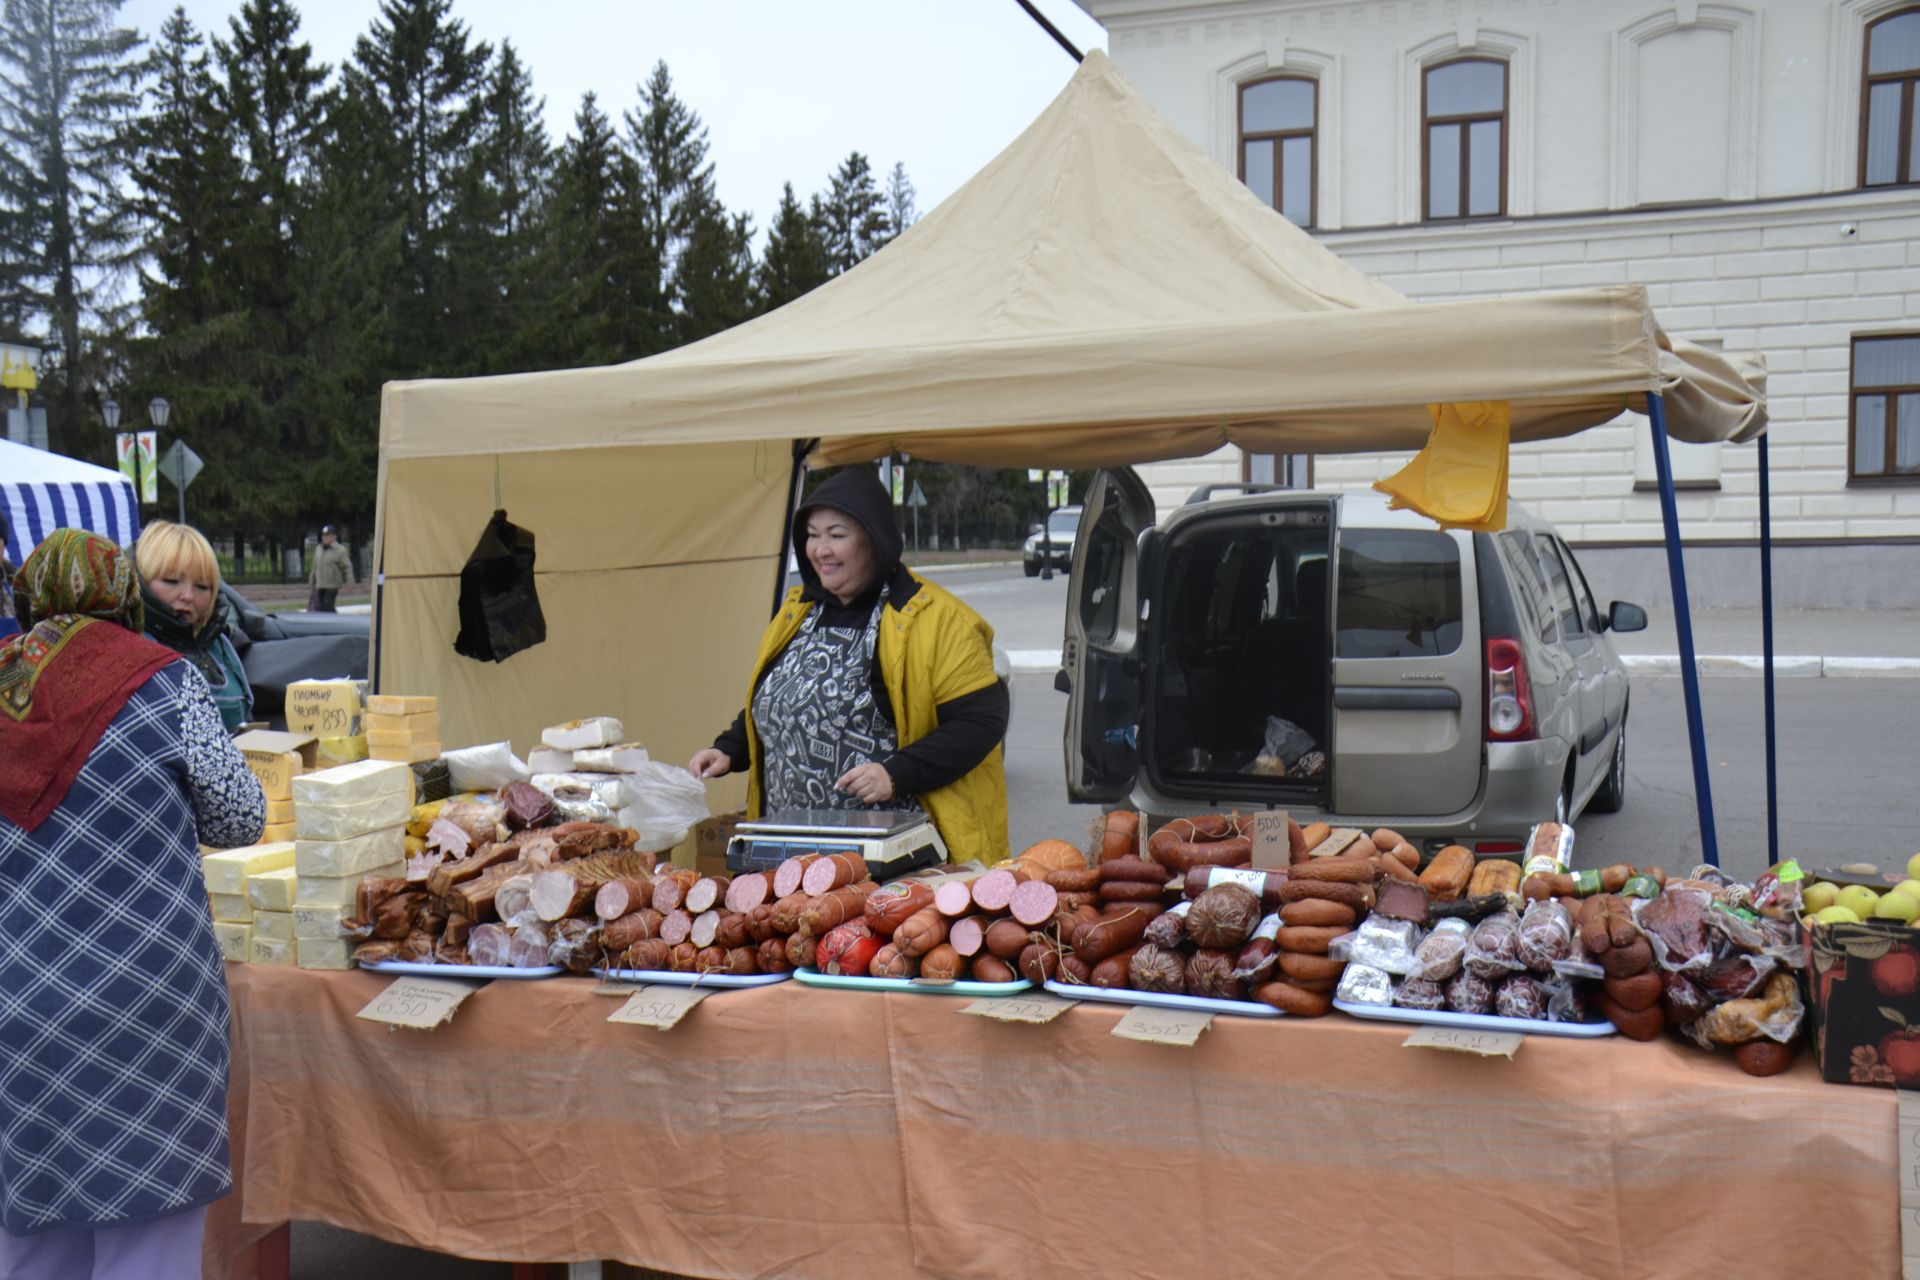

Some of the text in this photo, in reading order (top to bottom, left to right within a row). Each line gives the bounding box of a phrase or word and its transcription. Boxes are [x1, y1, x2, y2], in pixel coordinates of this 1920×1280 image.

[293, 689, 332, 702] ПЛОМБИР
[322, 708, 348, 731] 850
[1257, 815, 1281, 832] 500
[376, 998, 428, 1017] 650
[626, 1001, 676, 1020] 650
